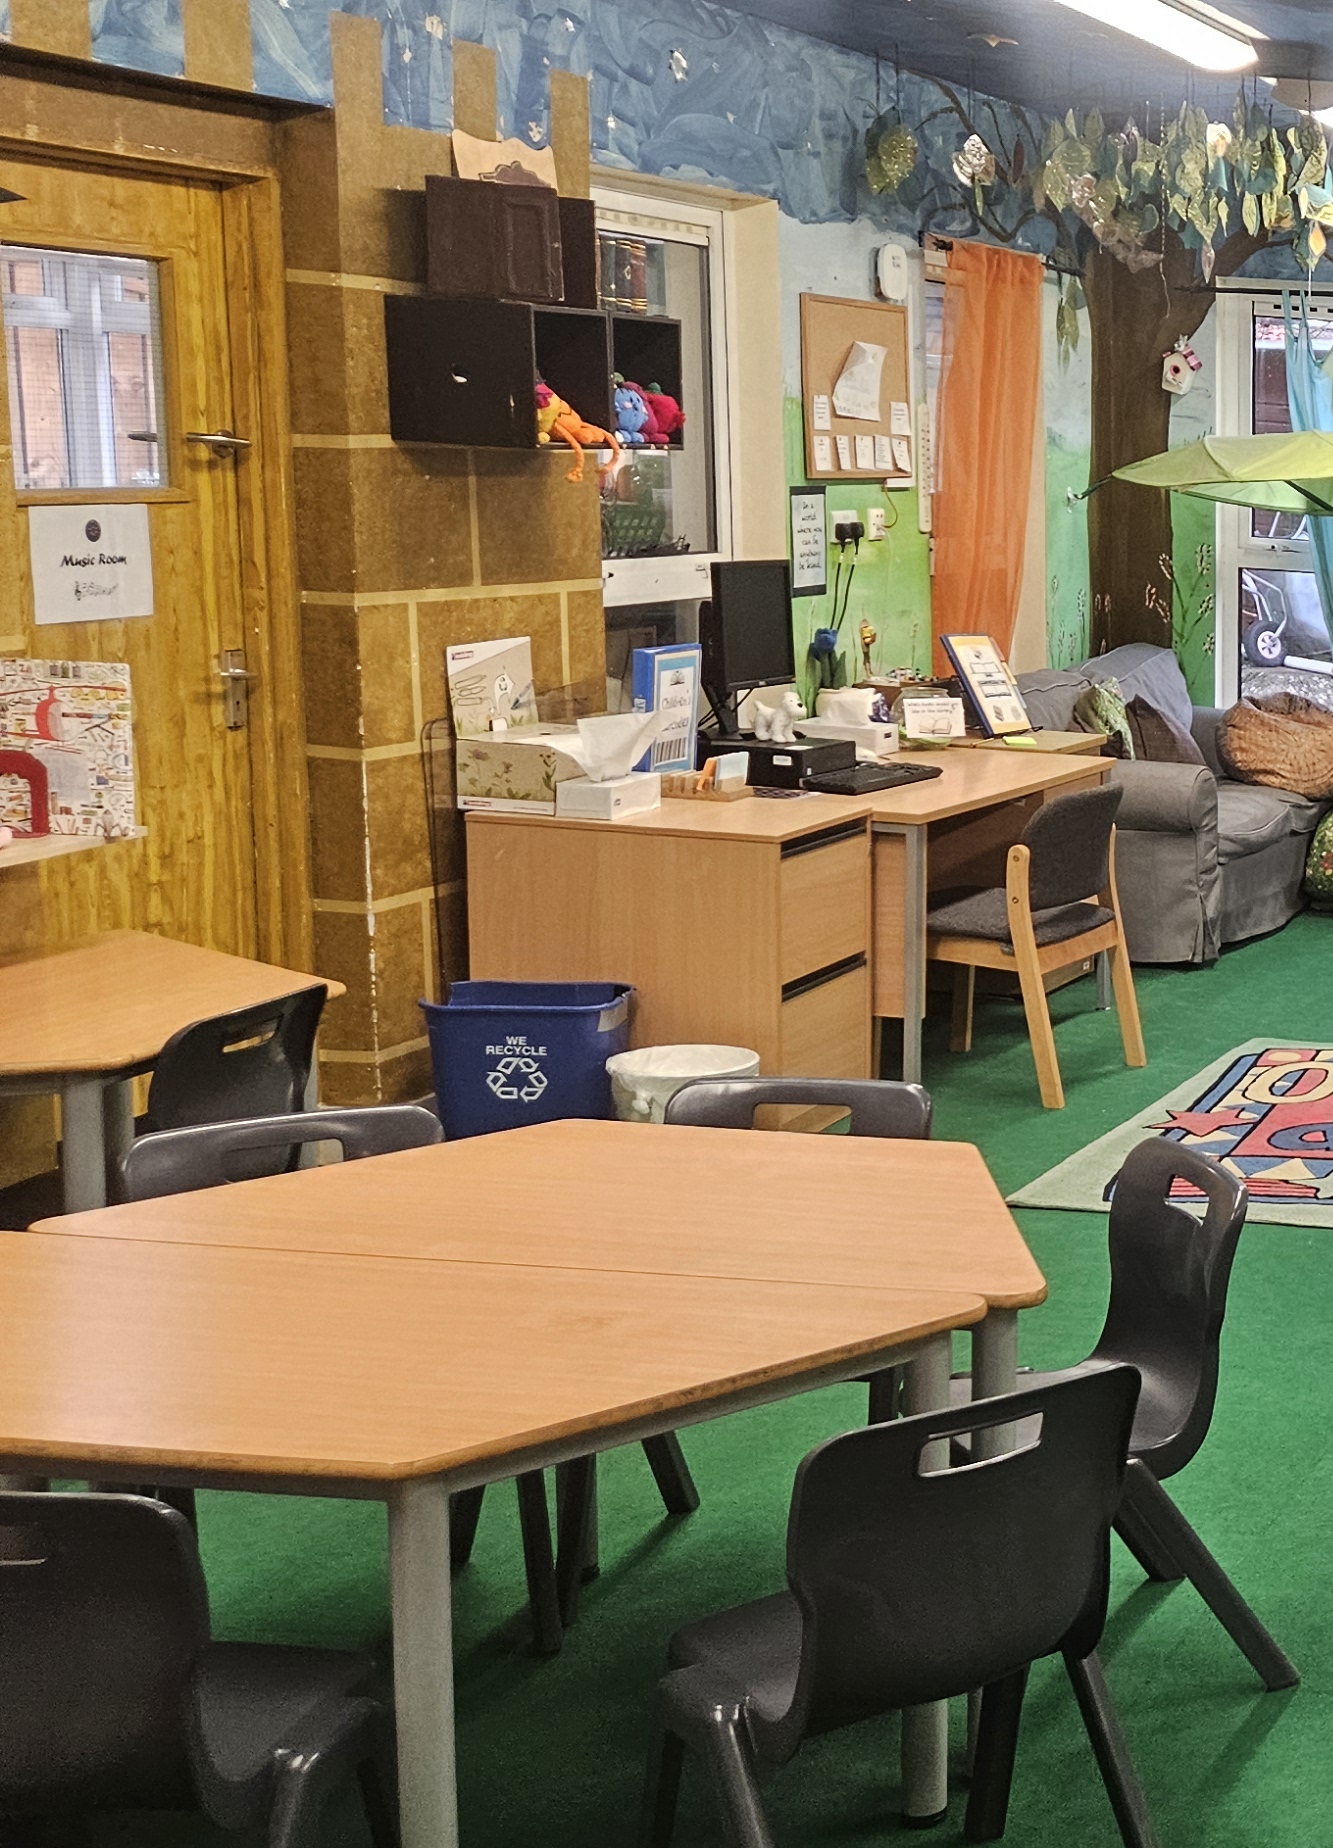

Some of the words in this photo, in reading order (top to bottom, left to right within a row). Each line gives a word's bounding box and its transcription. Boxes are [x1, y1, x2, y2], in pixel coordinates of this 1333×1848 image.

[60, 553, 95, 568] Music
[98, 552, 127, 565] Room
[506, 1036, 527, 1045] WE
[485, 1045, 548, 1056] RECYCLE
